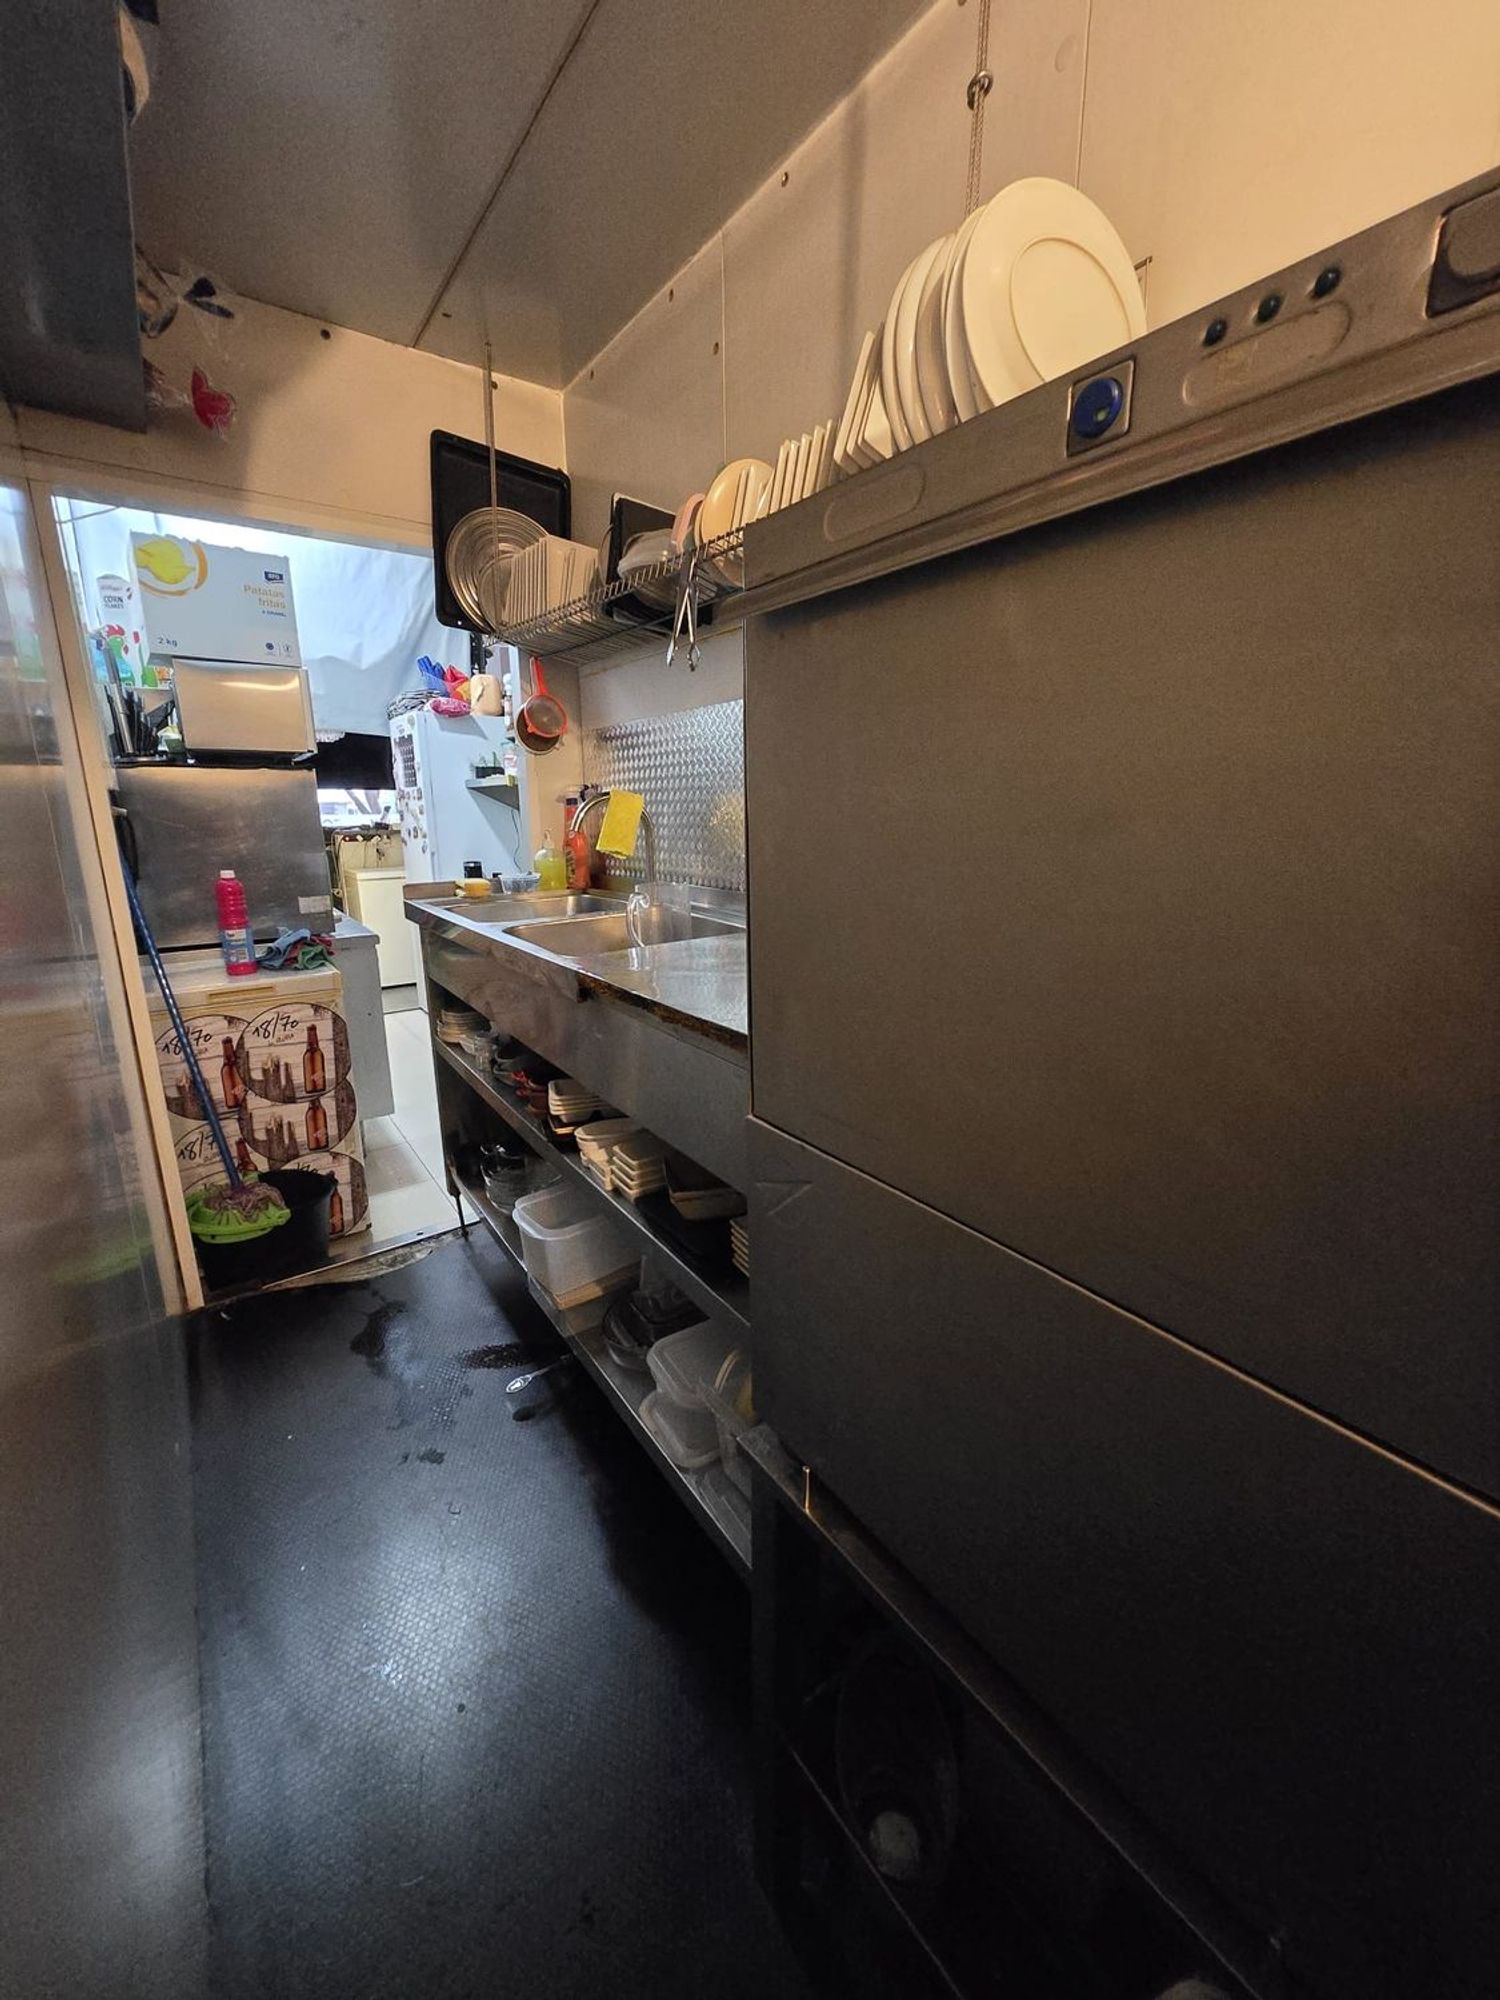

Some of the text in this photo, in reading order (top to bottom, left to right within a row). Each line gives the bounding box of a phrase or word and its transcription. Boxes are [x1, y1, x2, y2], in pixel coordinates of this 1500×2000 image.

[243, 584, 285, 599] Patatas
[103, 595, 124, 604] CORN
[258, 597, 287, 609] fritas
[252, 1012, 299, 1039] 18/70
[177, 1131, 215, 1160] 18/7
